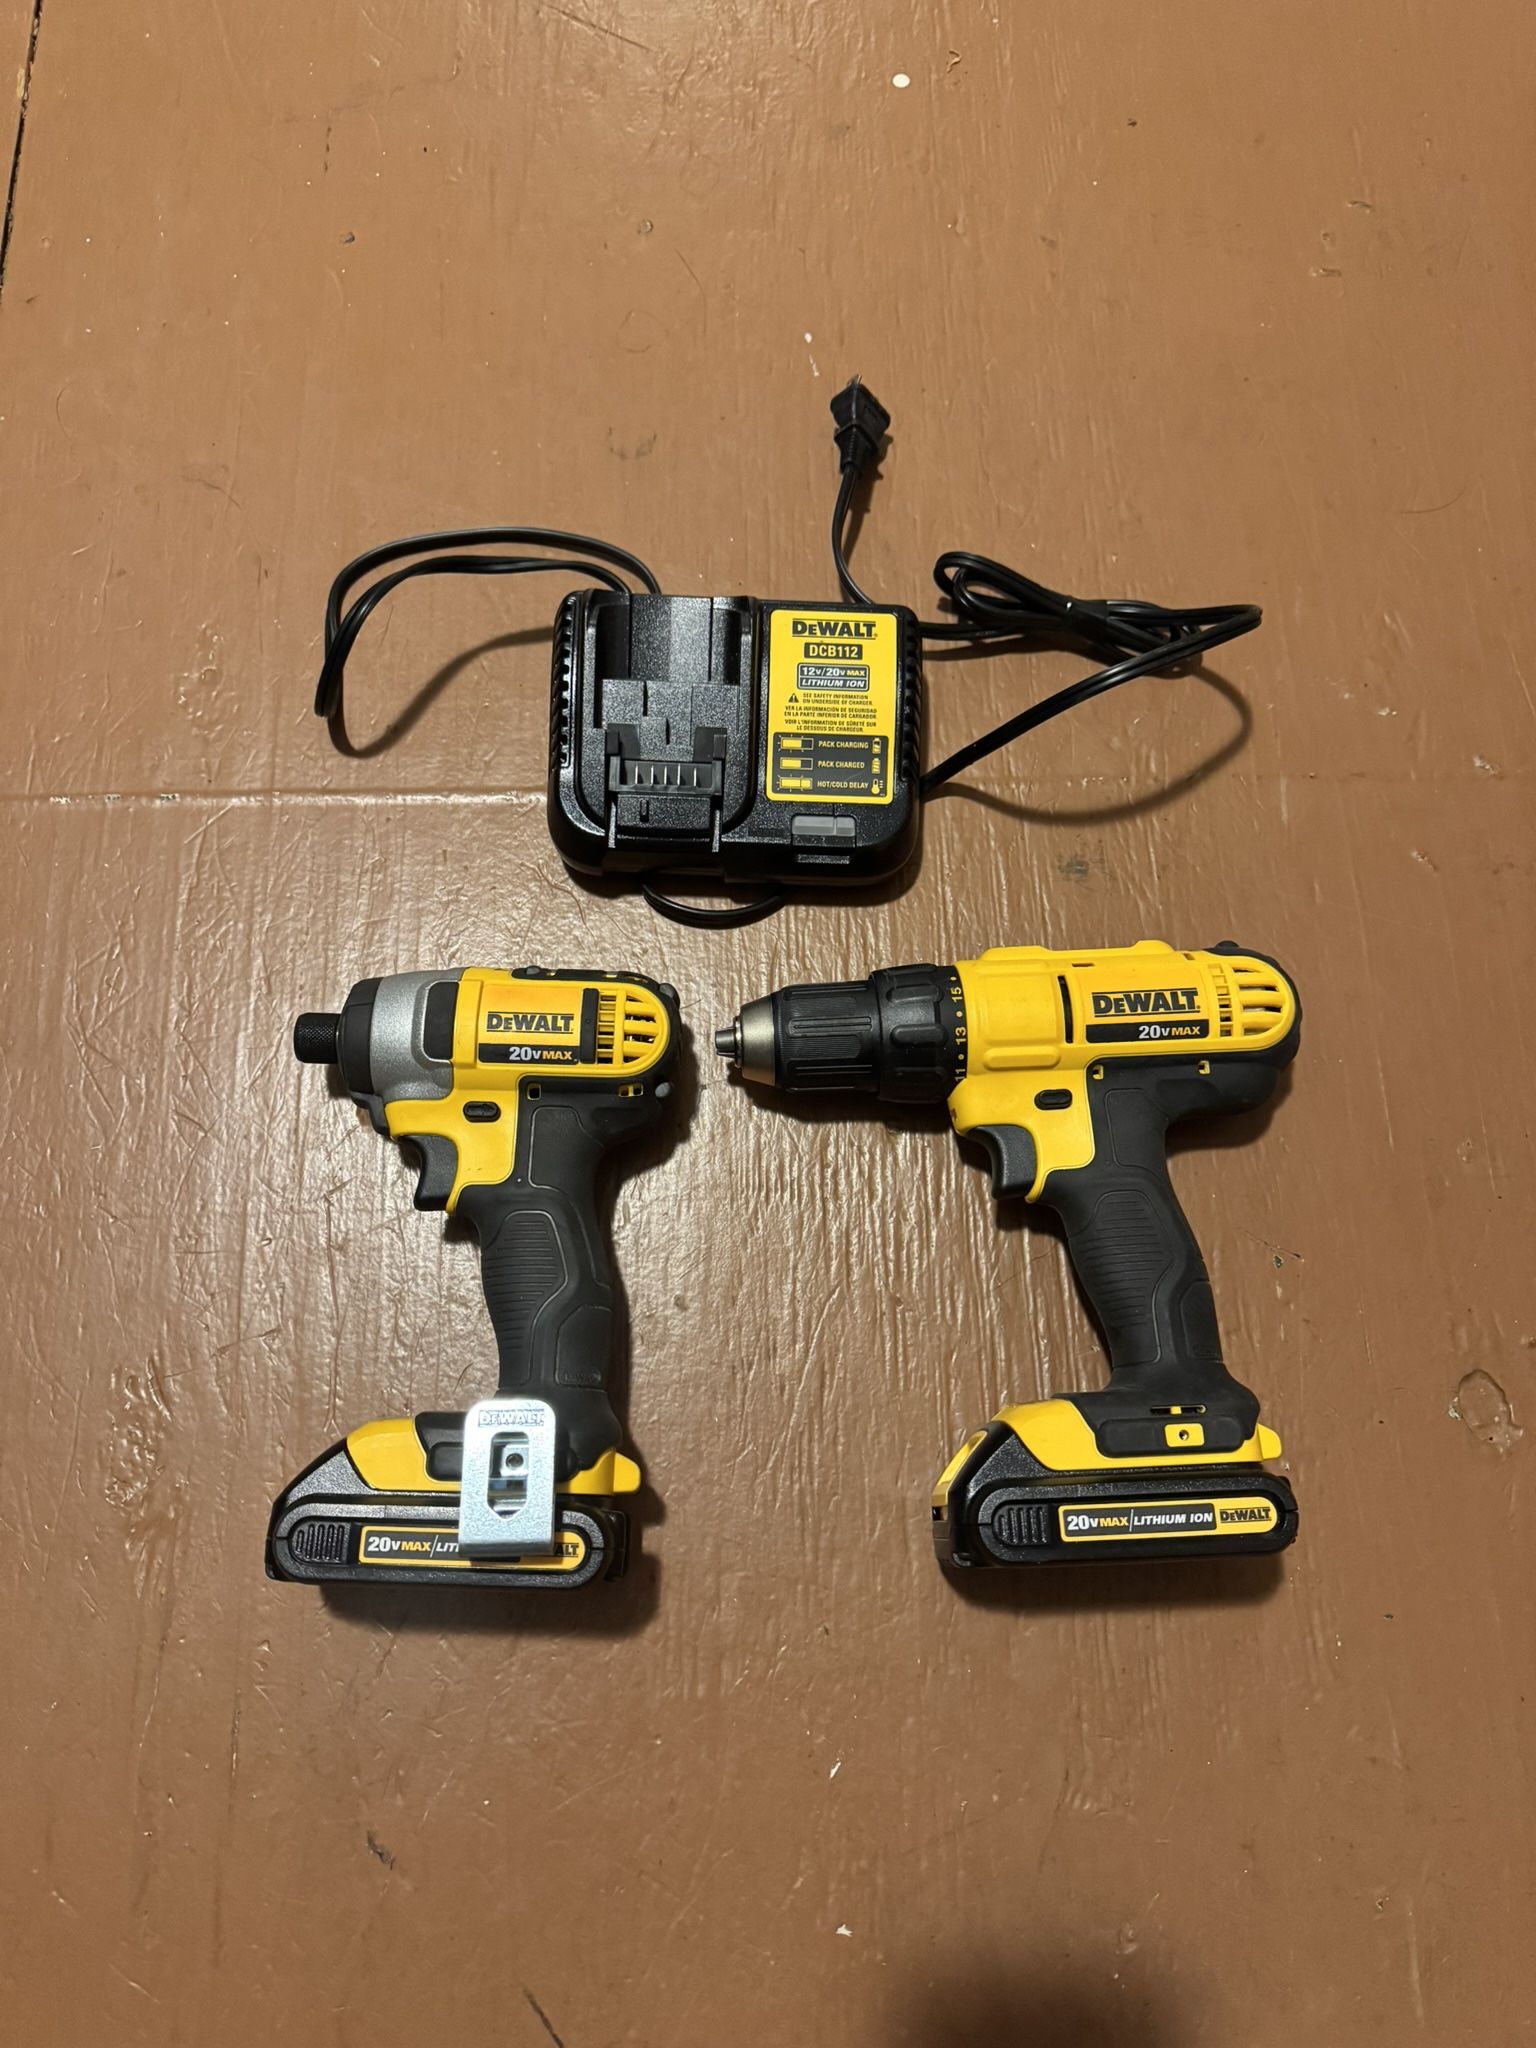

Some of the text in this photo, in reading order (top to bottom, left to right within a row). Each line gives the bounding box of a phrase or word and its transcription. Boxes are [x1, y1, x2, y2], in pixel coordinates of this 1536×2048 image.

[809, 644, 858, 658] DCB112
[801, 679, 844, 687] LITHIUM
[818, 740, 869, 750] PACK CHARGING
[818, 760, 865, 769] PACK CHARGED
[817, 780, 869, 789] HOT/COLD DELAY
[951, 986, 963, 1003] 15
[955, 1026, 966, 1046] 13
[954, 1068, 966, 1082] 11
[1133, 1512, 1186, 1526] LITHIUM
[1190, 1512, 1213, 1524] ION
